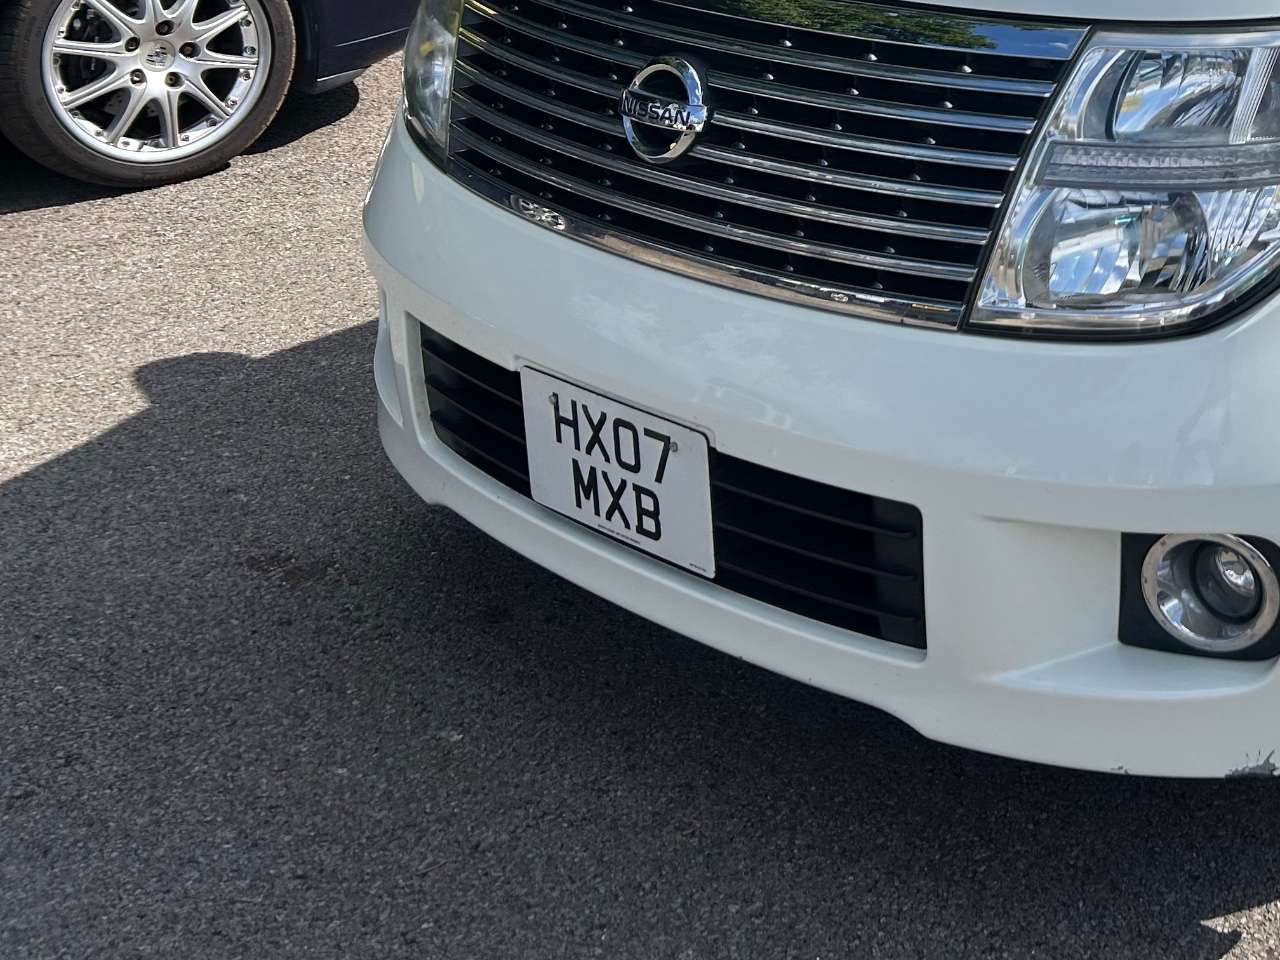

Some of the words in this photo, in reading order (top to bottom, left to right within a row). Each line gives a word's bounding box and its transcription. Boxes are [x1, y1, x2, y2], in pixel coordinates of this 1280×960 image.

[622, 95, 691, 126] NISSAN
[553, 392, 671, 484] HX07
[572, 458, 662, 541] MXB
